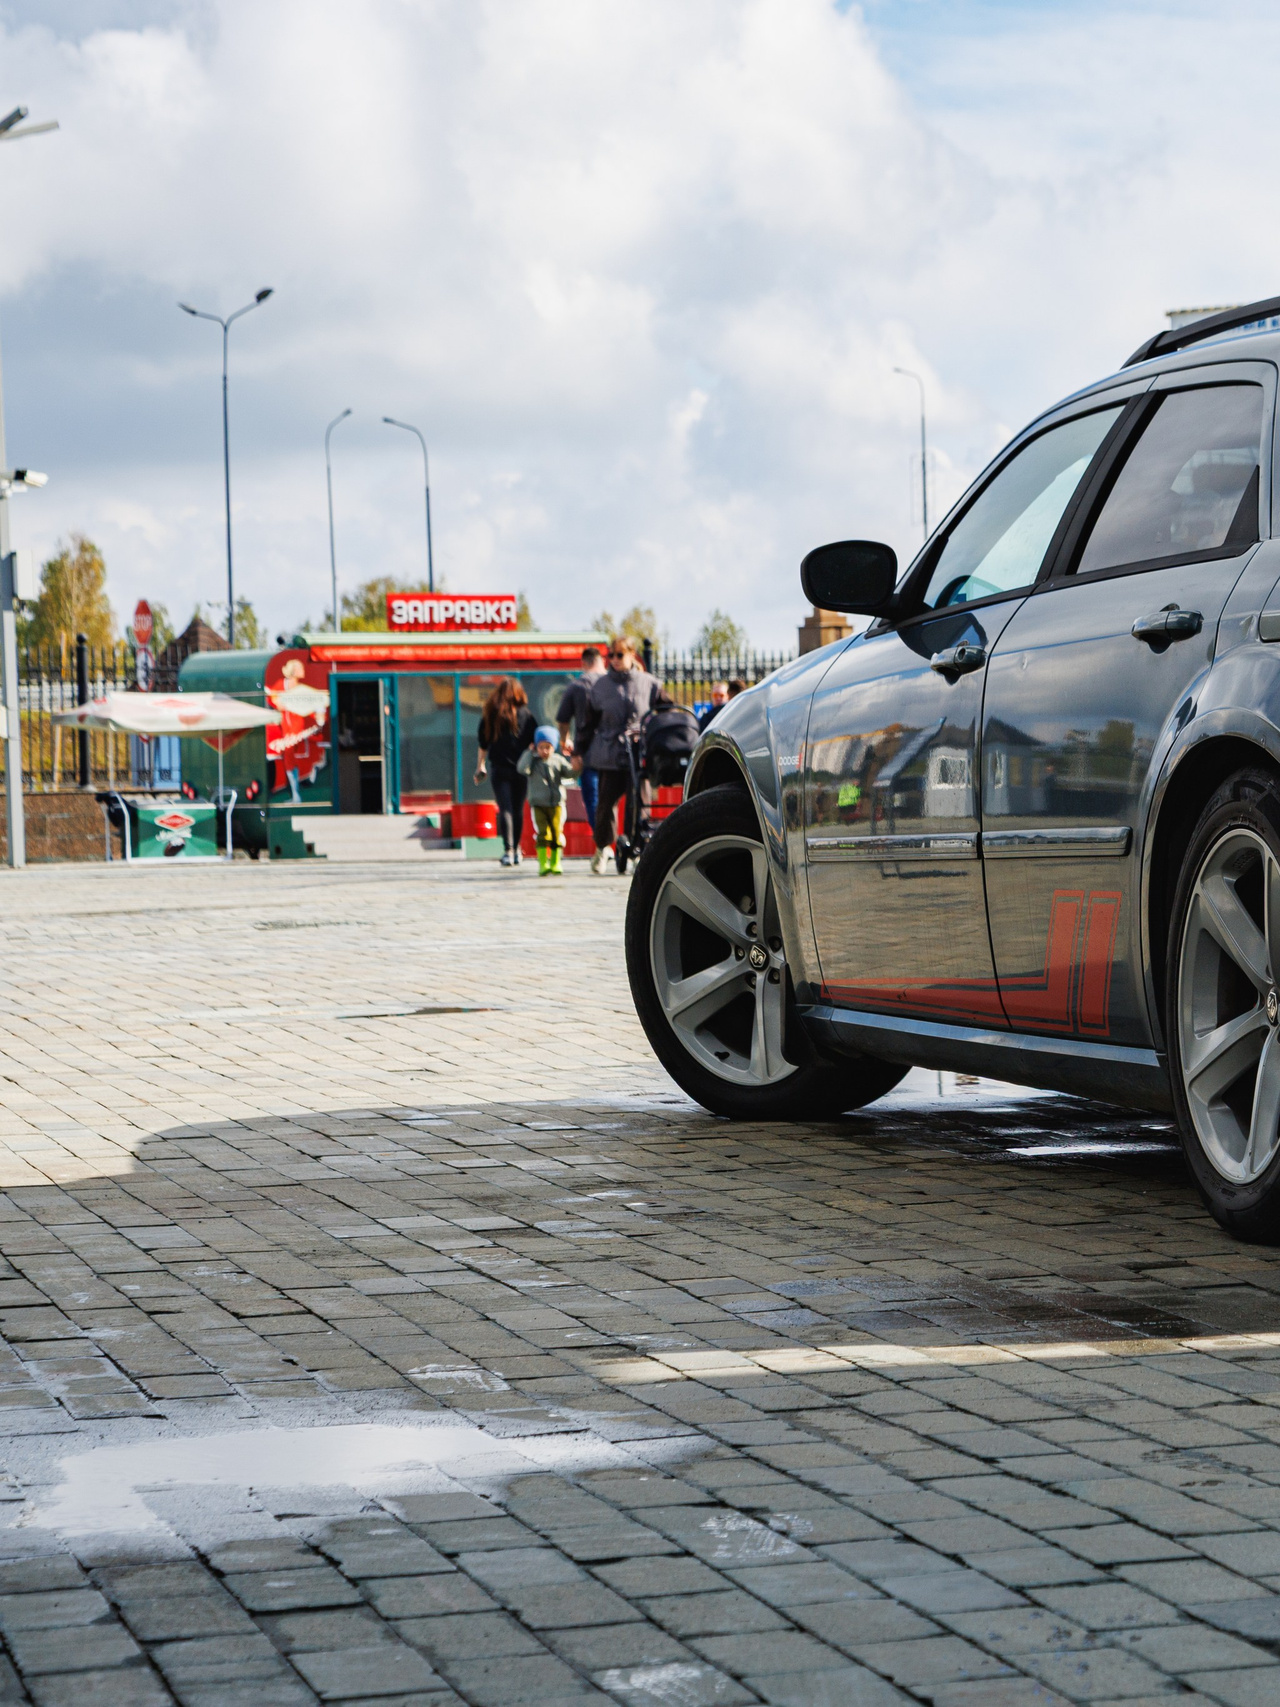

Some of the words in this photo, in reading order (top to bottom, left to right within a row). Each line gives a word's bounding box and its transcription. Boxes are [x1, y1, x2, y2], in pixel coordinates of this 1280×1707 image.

[391, 599, 517, 624] ЗАПРАВКА
[133, 613, 152, 631] STOP
[779, 755, 800, 766] DODGE
